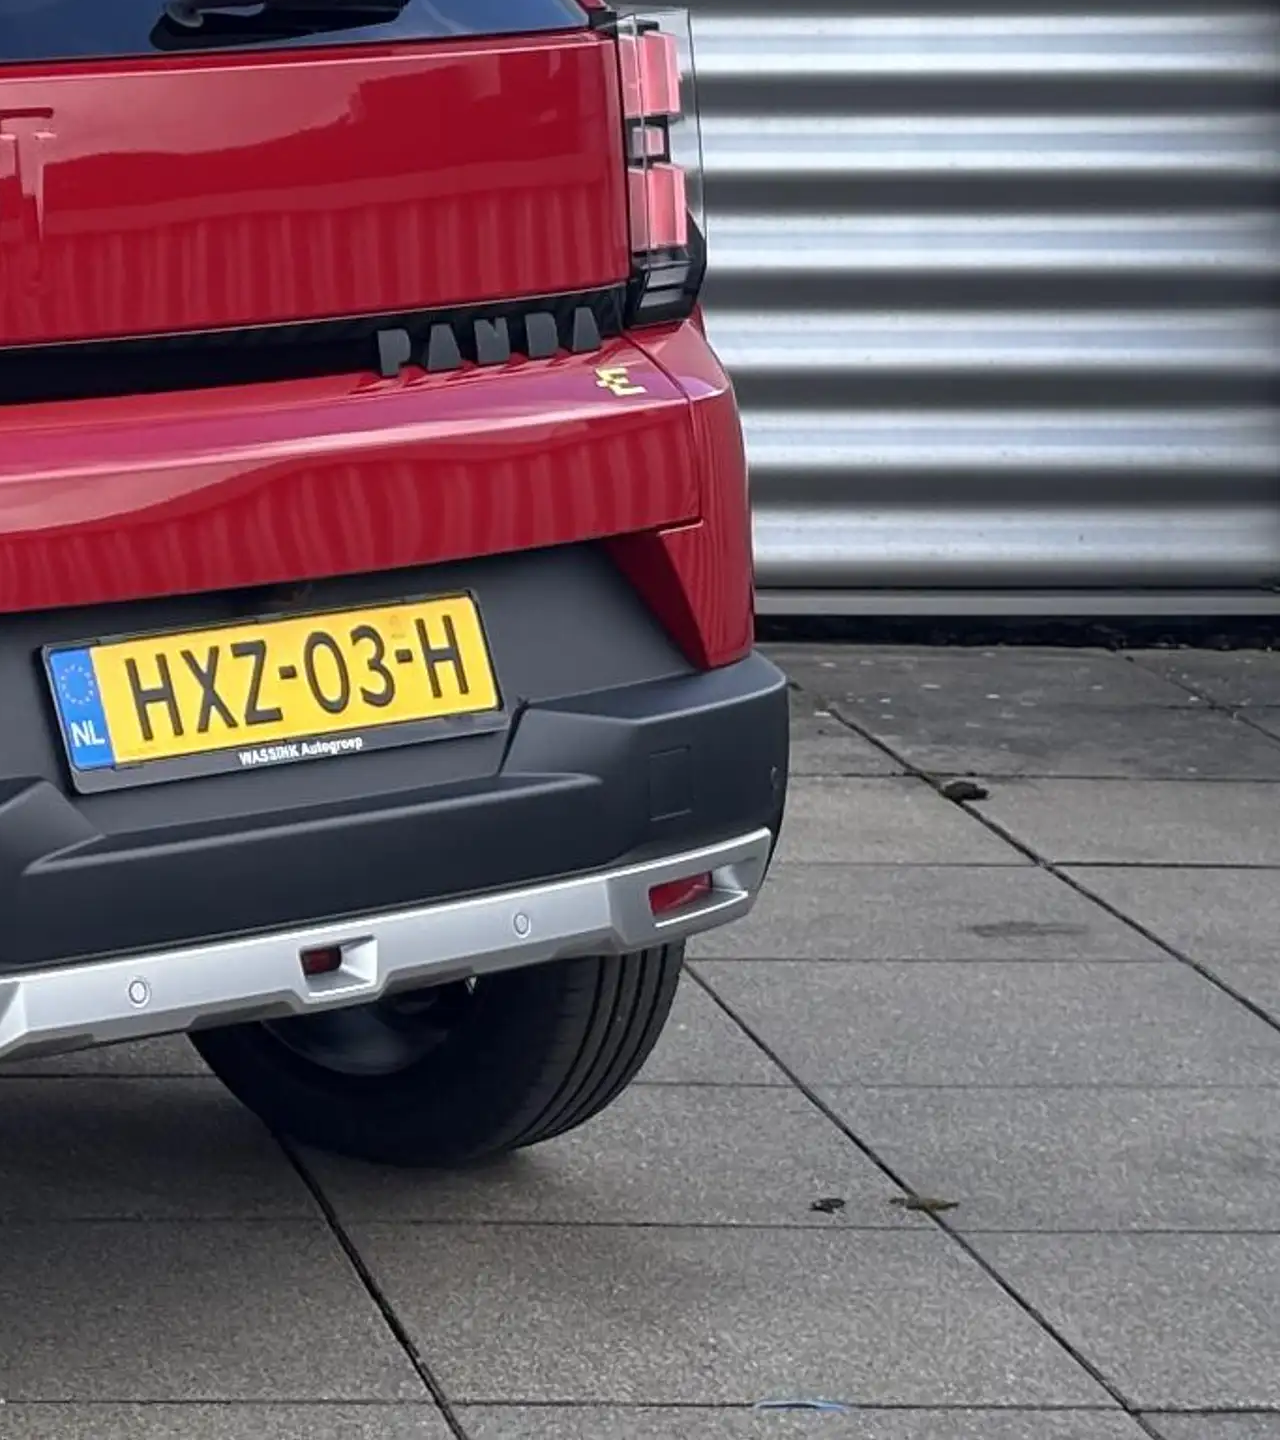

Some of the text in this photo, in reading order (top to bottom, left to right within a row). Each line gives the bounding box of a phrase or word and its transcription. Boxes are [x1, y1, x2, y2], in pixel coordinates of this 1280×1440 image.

[376, 306, 601, 378] PANDA
[124, 614, 470, 742] HXZ-03-H
[71, 722, 106, 748] NL
